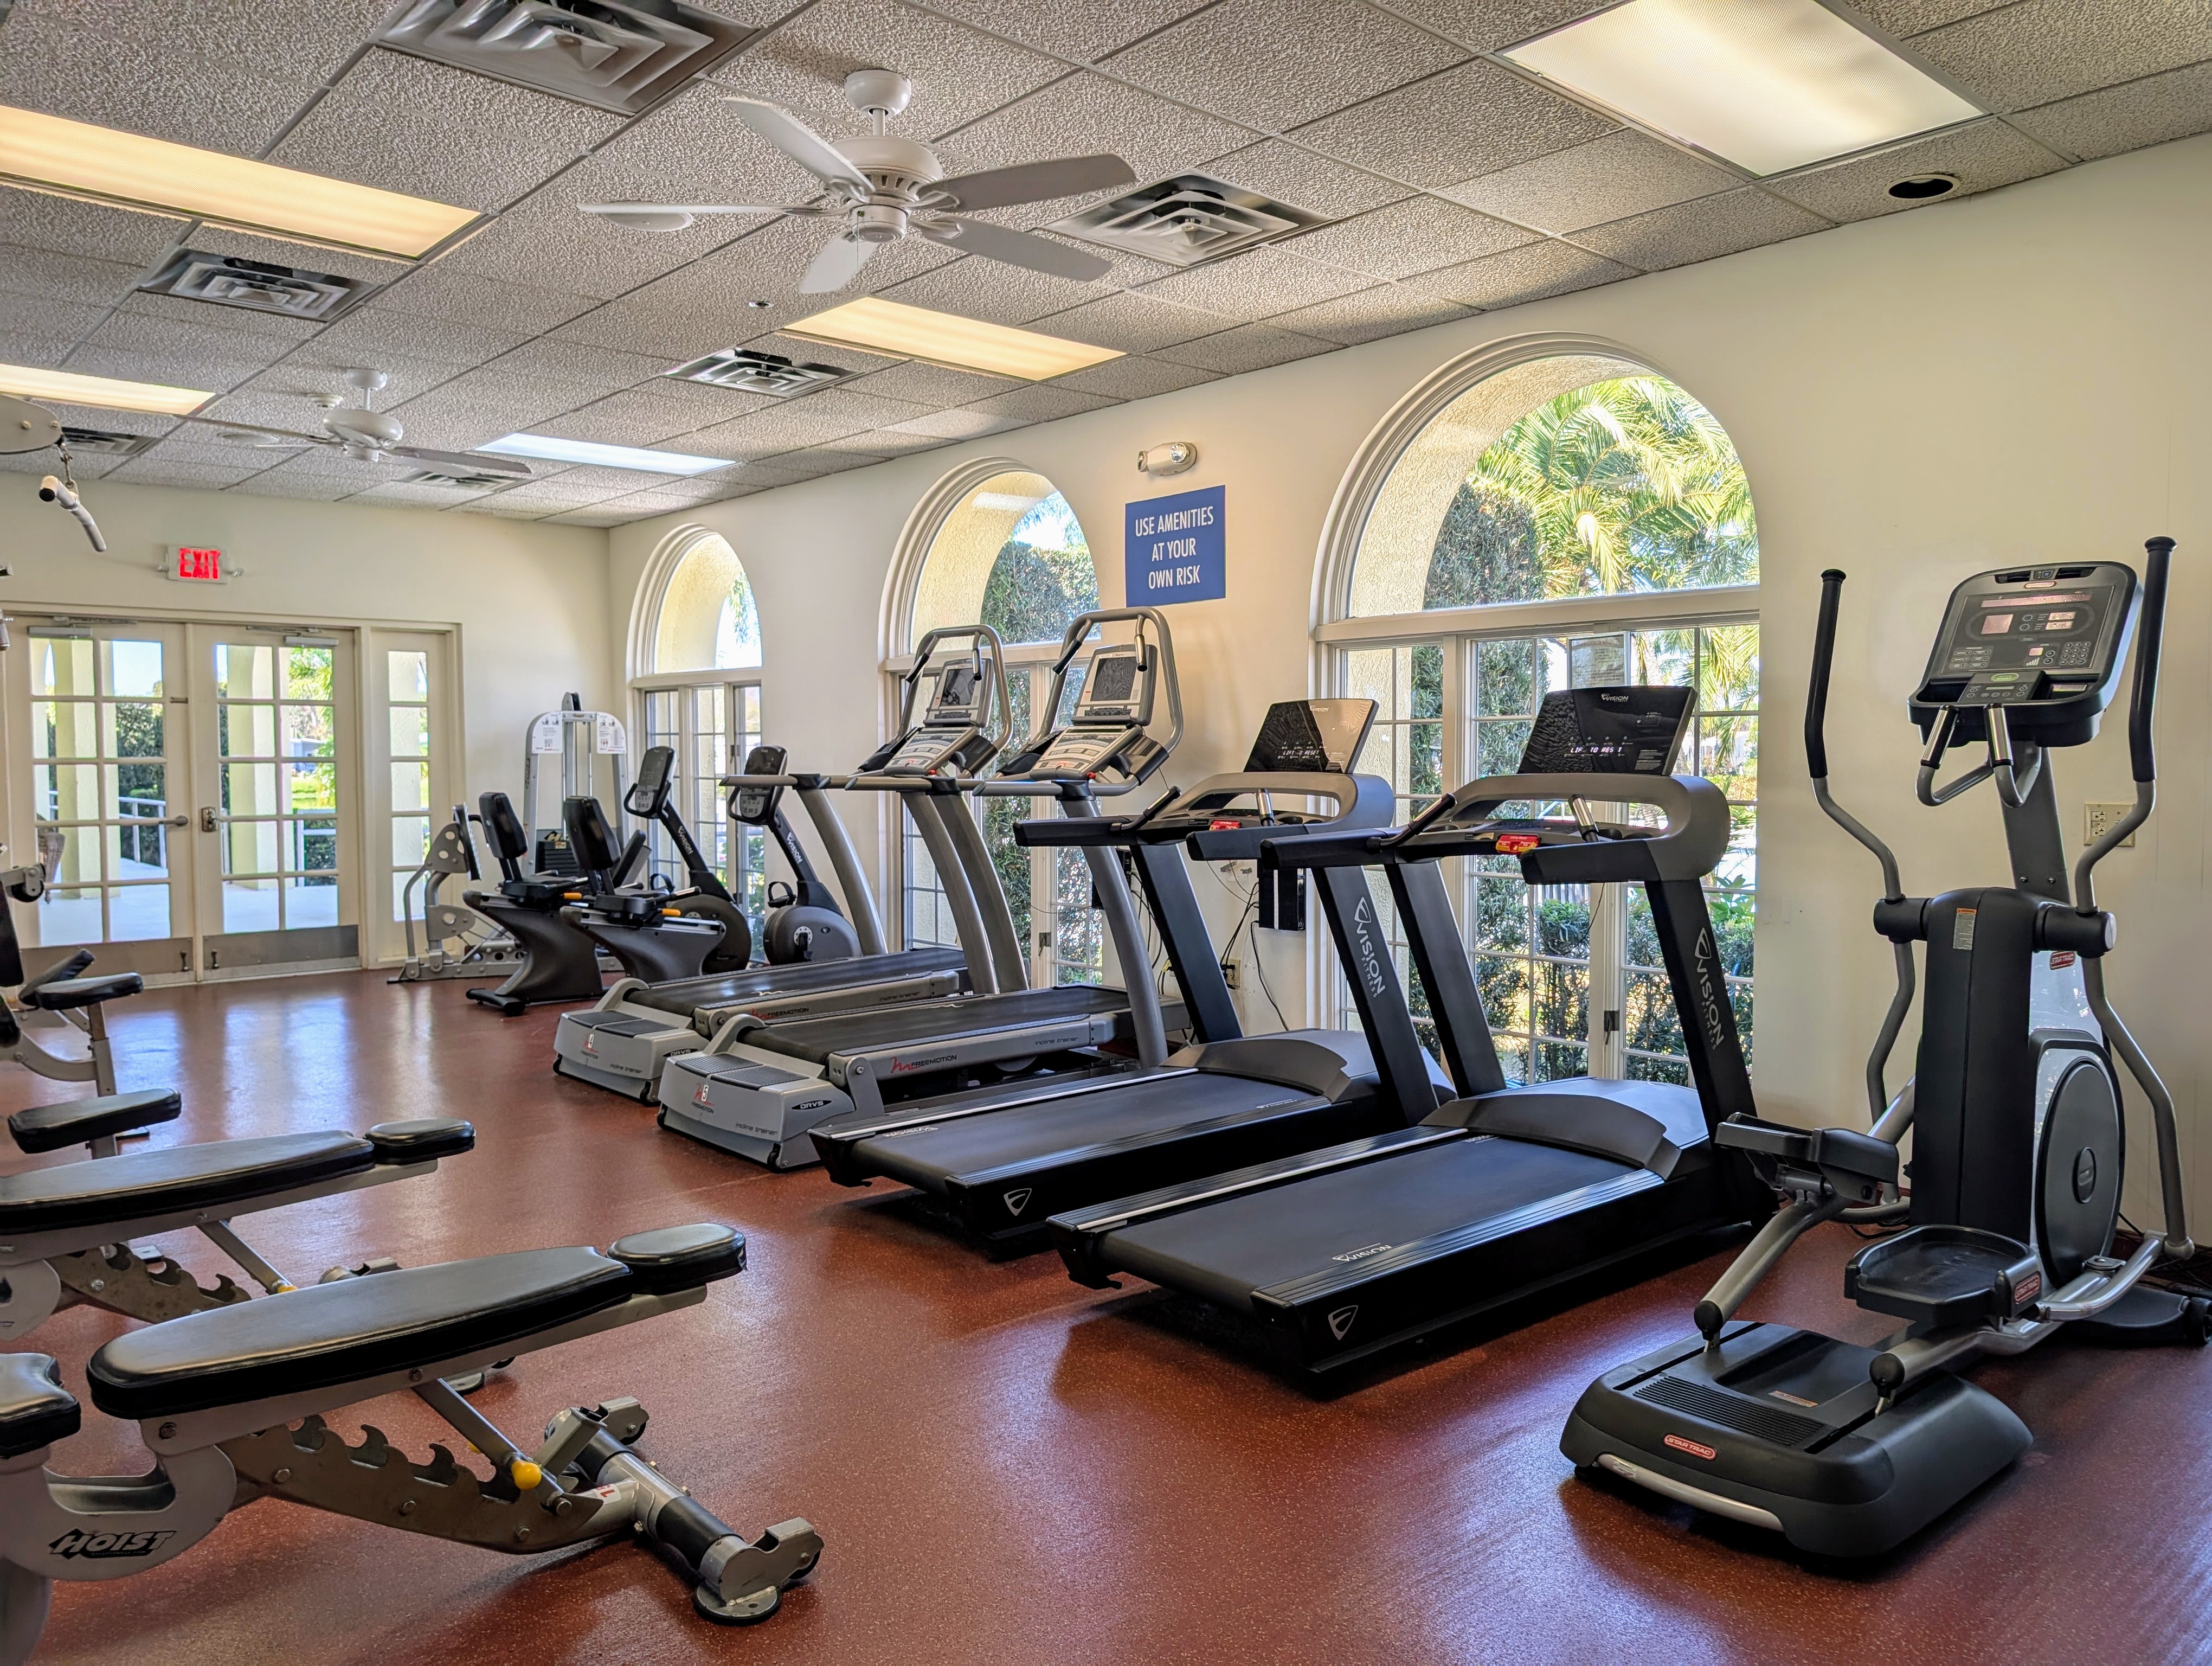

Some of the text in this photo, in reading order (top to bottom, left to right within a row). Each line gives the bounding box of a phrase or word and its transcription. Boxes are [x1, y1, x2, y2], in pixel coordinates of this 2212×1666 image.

[1135, 506, 1214, 537] USE AMENITIES
[1152, 538, 1197, 562] AT YOUR
[179, 548, 221, 580] EXIT
[1148, 565, 1200, 589] OWN RISK
[1356, 922, 1386, 995] VISION
[1361, 957, 1378, 998] FITNESS
[768, 1007, 809, 1017] FREEMOTION
[1696, 959, 1725, 1046] VISION
[911, 1054, 957, 1067] FREEMOTION
[800, 1100, 824, 1110] DRVS
[1349, 1245, 1392, 1260] VISION
[1666, 1436, 1712, 1456] STAR TRAC
[50, 1530, 177, 1554] HOIST
